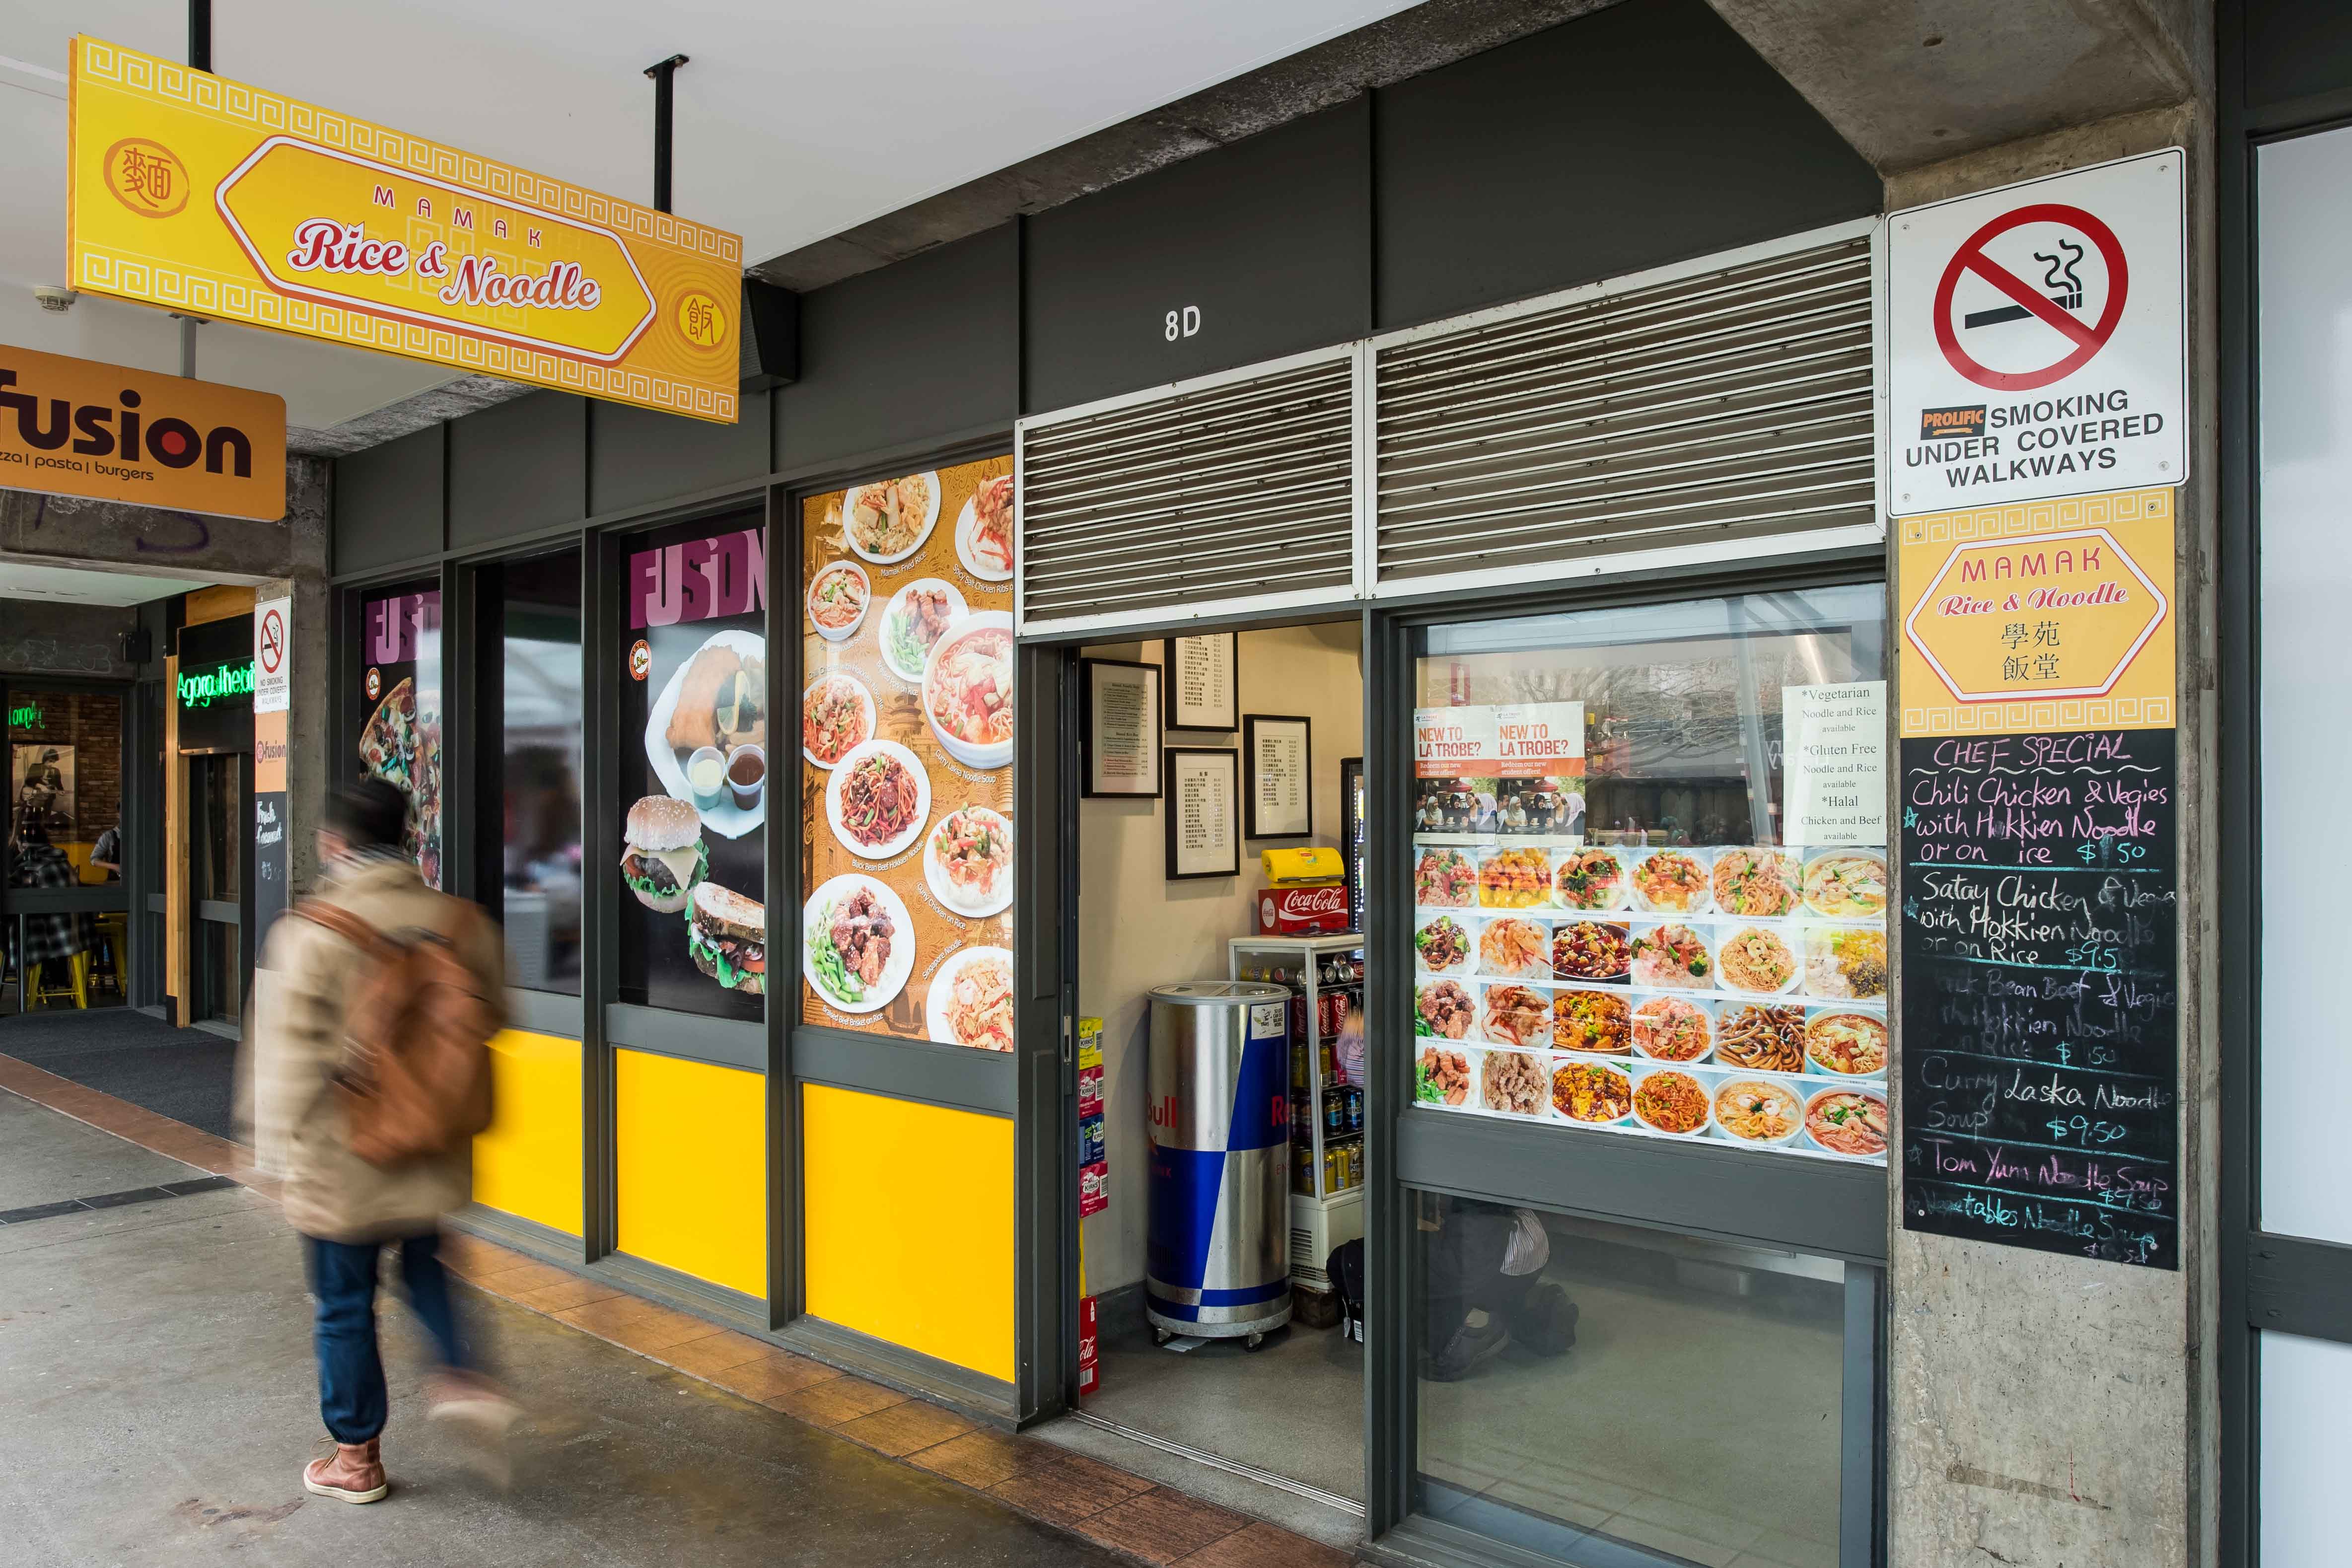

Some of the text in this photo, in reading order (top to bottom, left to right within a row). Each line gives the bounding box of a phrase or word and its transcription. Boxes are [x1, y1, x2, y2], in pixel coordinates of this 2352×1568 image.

[123, 147, 171, 208] 麵
[373, 185, 542, 249] MAMAK
[287, 218, 601, 310] Rice & Noodle
[687, 298, 715, 345] 飯
[1165, 305, 1201, 342] 8D
[1924, 409, 1984, 428] PROLIFIC
[1990, 390, 2128, 428] SMOKING
[1906, 414, 2163, 467] UNDER COVERED
[35, 456, 154, 481] pasta burgers
[1946, 447, 2117, 488] WALKWAYS
[880, 551, 927, 577] Mamak Fried Rice
[953, 564, 1008, 593] Spicy Salt Chicken Ribs
[1961, 547, 2101, 583] MAMAK
[1938, 581, 2129, 617] Rice & Noodle
[2001, 621, 2061, 649] 學苑
[267, 676, 283, 685] SMOKING
[2002, 653, 2061, 682] 飯堂
[908, 687, 918, 696] Rice
[1803, 707, 1876, 718] Noodle and Rice
[1419, 727, 1463, 742] NEW TO
[1499, 723, 1548, 739] NEW TO
[1822, 724, 1855, 732] available
[1419, 741, 1481, 757] LA TROBE?
[1500, 739, 1568, 756] LA TROBE?
[1852, 743, 1877, 755] Free
[1934, 738, 2010, 775] CHEF
[935, 750, 997, 784] Curry Laksa Noodle Soup
[1803, 763, 1877, 774] Noodle and Rice
[1913, 776, 2167, 813] Chili Chicken & Vegies
[1801, 815, 1882, 825] Chicken and Beef
[1916, 805, 2155, 841] with Hkkien Noodle
[852, 841, 925, 871] Black Bean Beef Hokkien Noodle
[1921, 843, 1988, 861] or on
[918, 883, 966, 930] Curry Chicken on Rice
[1284, 888, 1344, 913] Coca-Cola
[1923, 872, 1989, 910] Satay
[1997, 875, 2084, 912] Chicken
[1920, 905, 1965, 933] with
[1970, 905, 2065, 942] Hokkien
[923, 939, 962, 980] Singapore Noodle
[1955, 941, 1983, 957] on
[1990, 937, 2038, 965] Rice
[823, 1005, 838, 1021] Braised
[839, 1016, 850, 1025] Beef
[850, 1017, 866, 1026] Brisket
[872, 1012, 883, 1022] Rice
[1080, 1038, 1092, 1047] KIRKS
[1081, 1086, 1094, 1095] KIRKS
[1922, 1056, 1997, 1114] Curry
[2004, 1069, 2085, 1106] Laska
[1094, 1131, 1104, 1140] KIRKS
[1927, 1102, 2127, 1145] Soup $9.50
[1919, 1137, 1977, 1174] Tom
[1986, 1146, 2029, 1184] Yum
[1084, 1182, 1099, 1191] KIRKS
